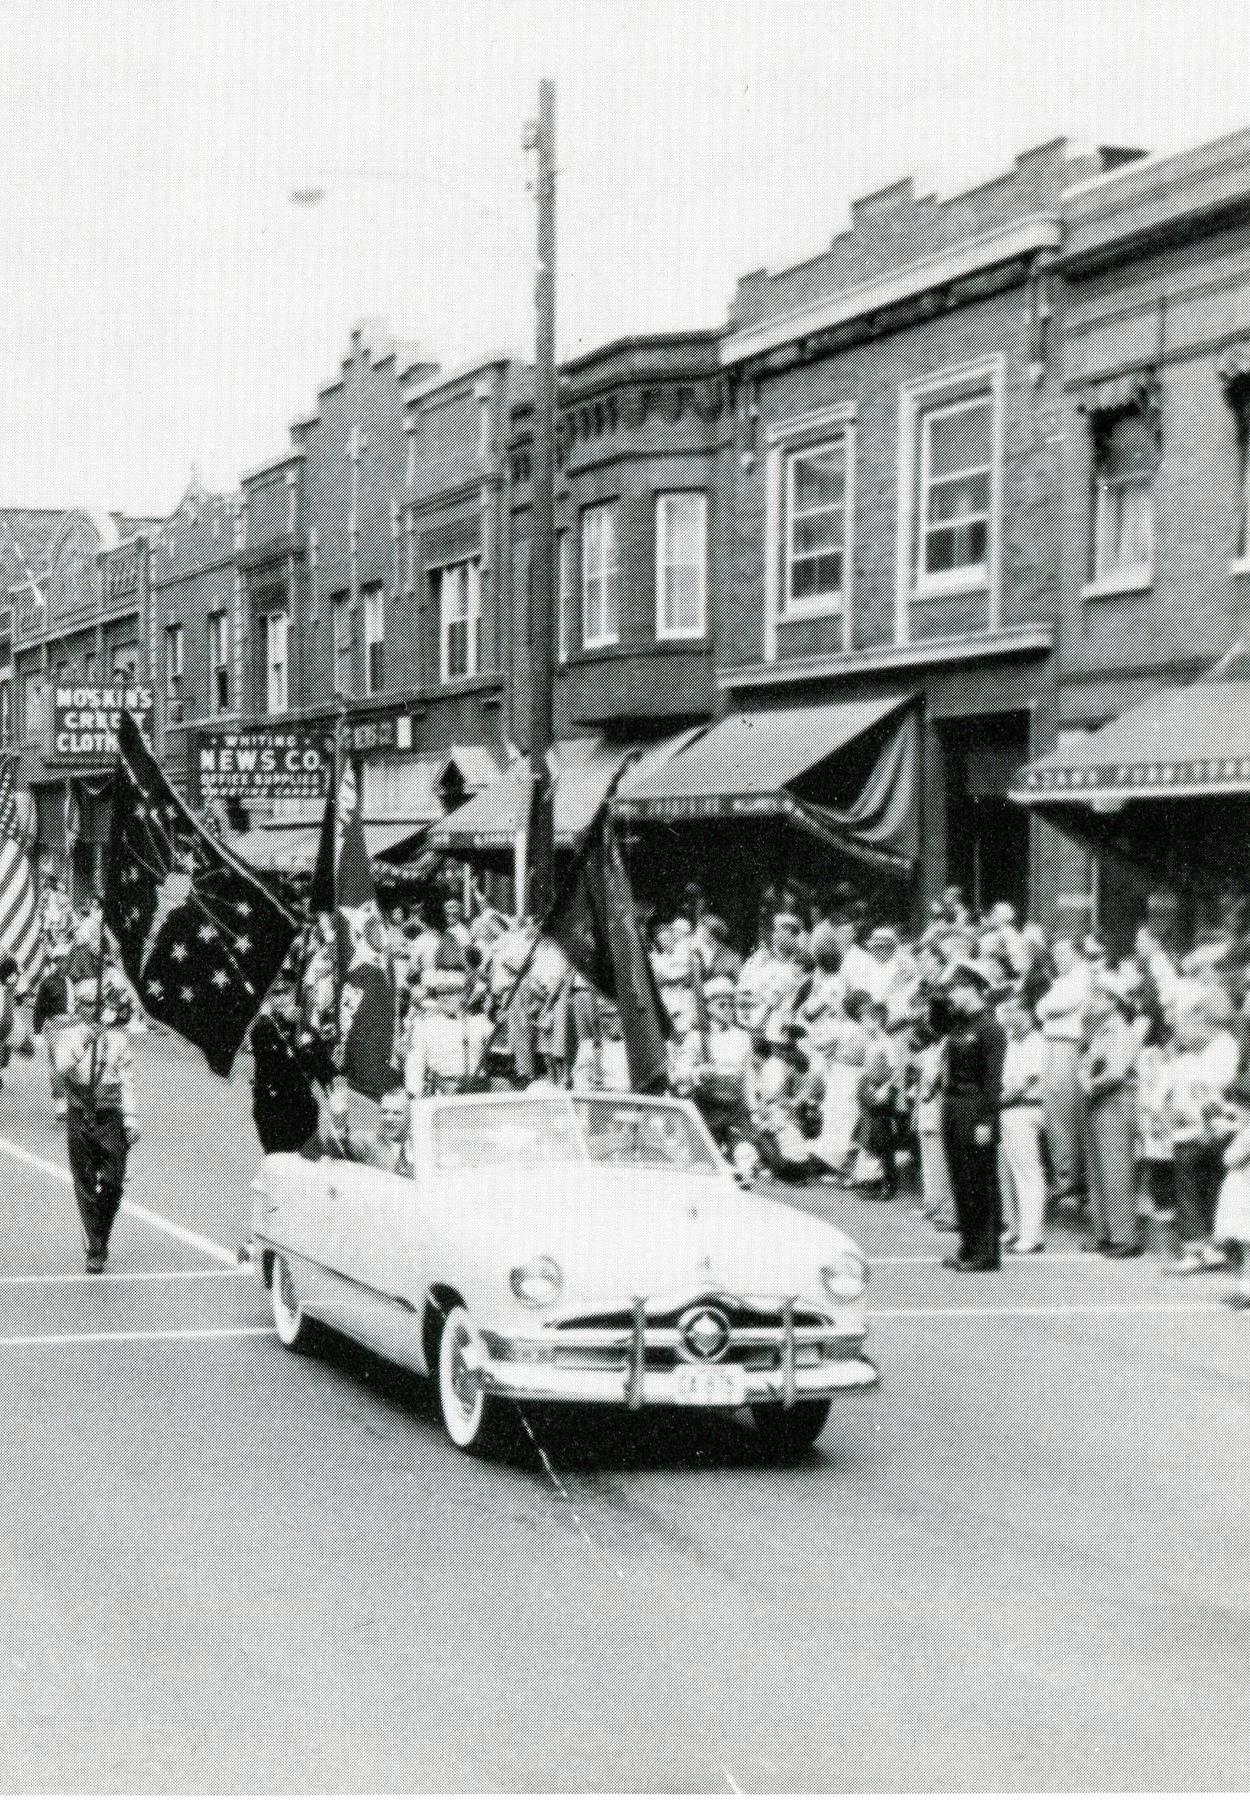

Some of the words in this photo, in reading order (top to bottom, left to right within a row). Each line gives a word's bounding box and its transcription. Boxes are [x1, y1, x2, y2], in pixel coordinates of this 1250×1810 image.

[223, 735, 297, 747] WHITING
[200, 749, 277, 771] NEWS
[200, 773, 249, 785] OFFICE
[253, 773, 320, 785] SUPPLIES
[274, 786, 320, 796] CARDS
